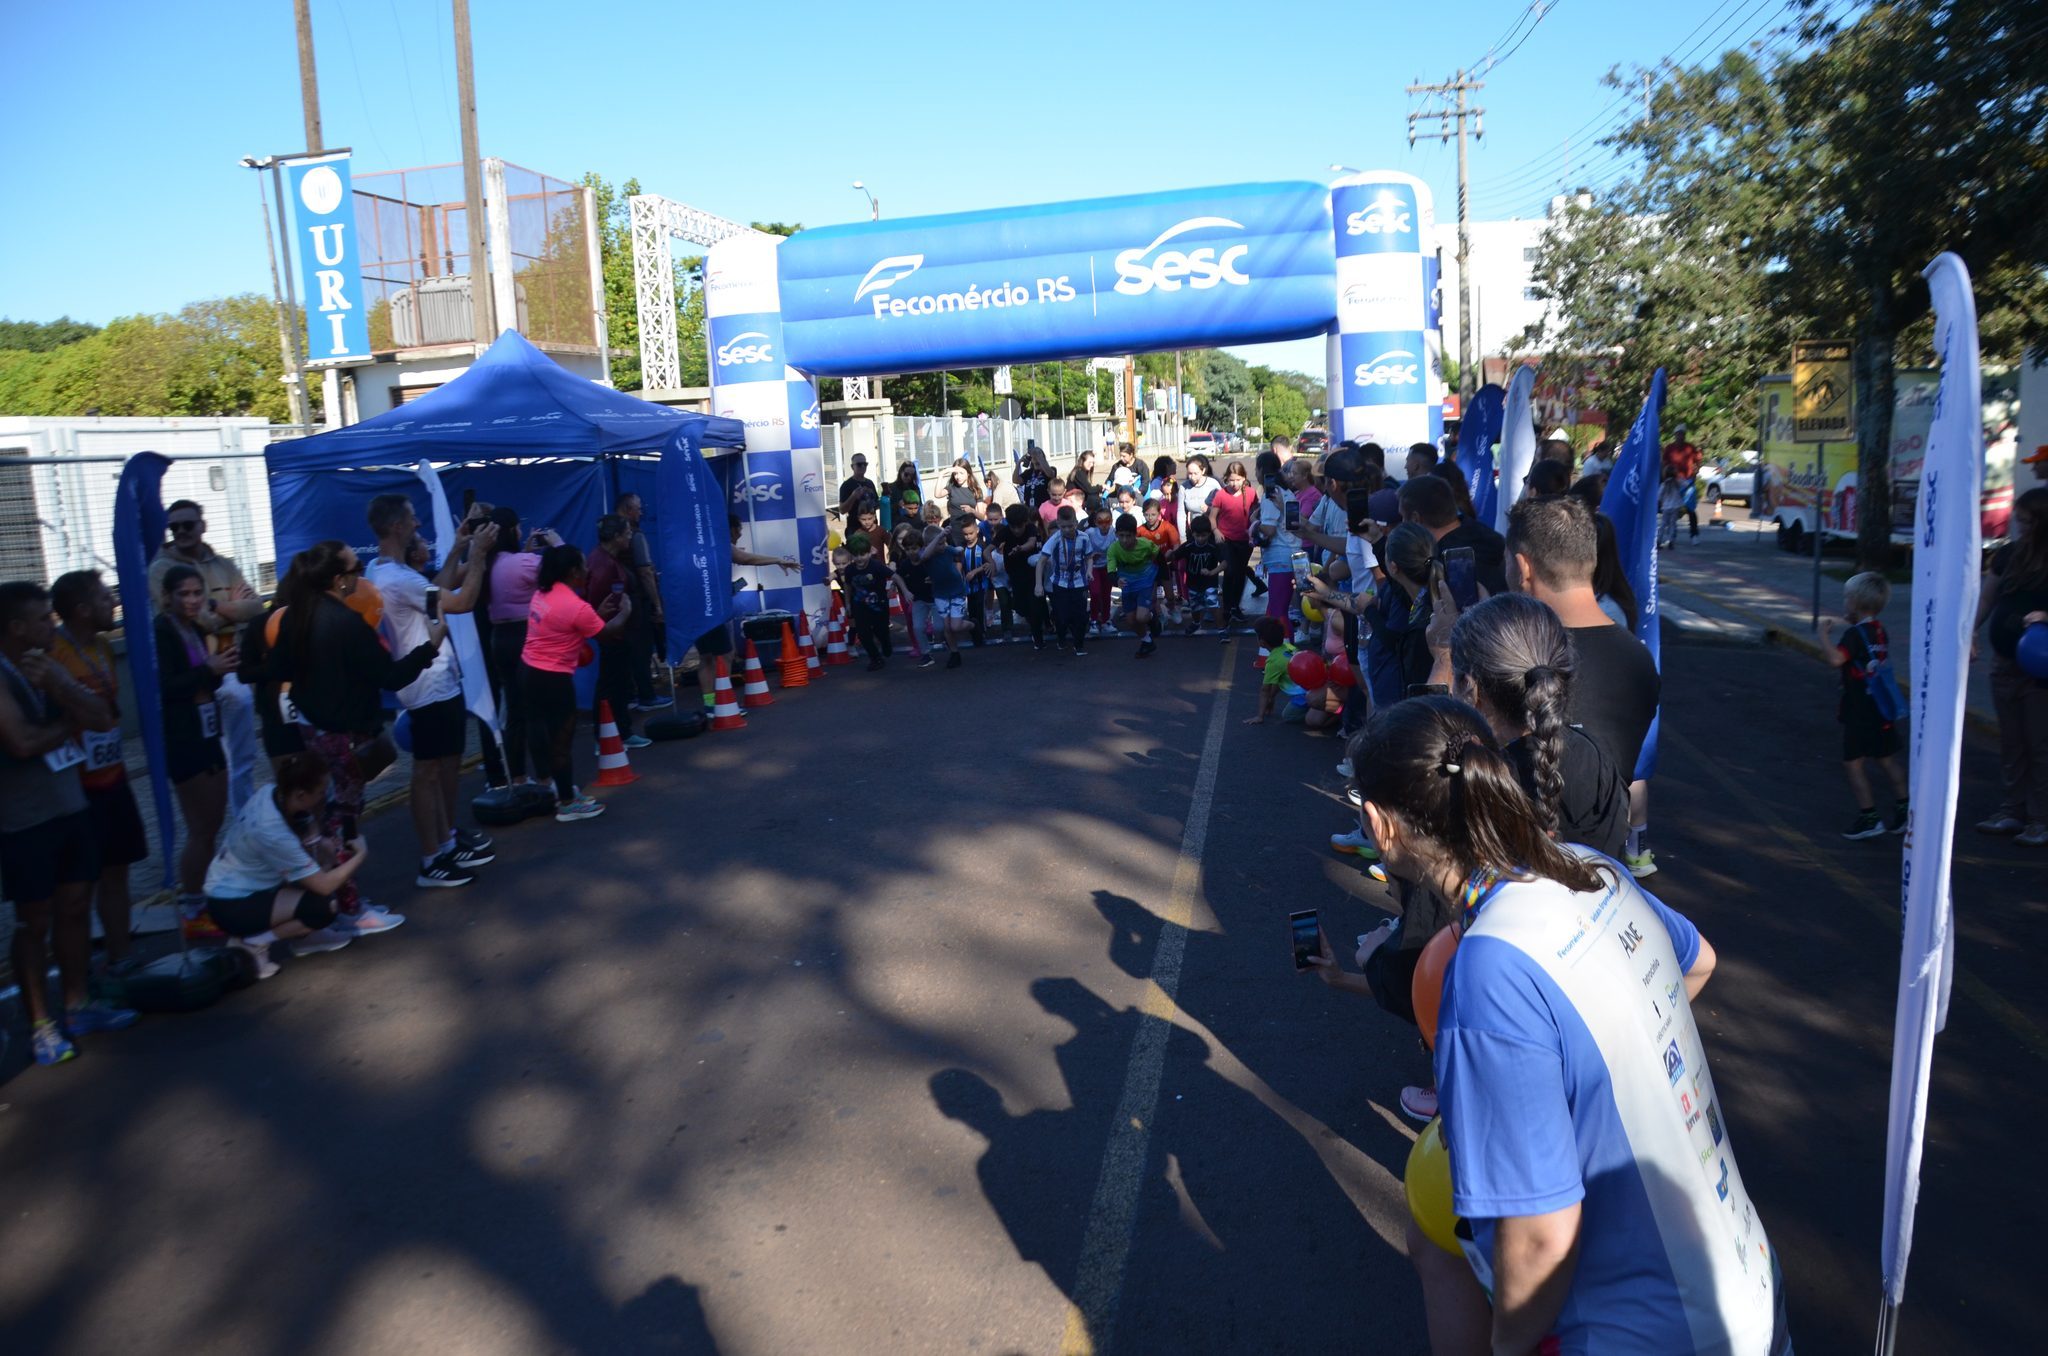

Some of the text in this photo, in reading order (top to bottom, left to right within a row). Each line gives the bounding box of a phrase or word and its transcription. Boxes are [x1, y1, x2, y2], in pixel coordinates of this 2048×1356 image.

[308, 223, 352, 355] URI
[873, 275, 1076, 320] Fecomércio RS
